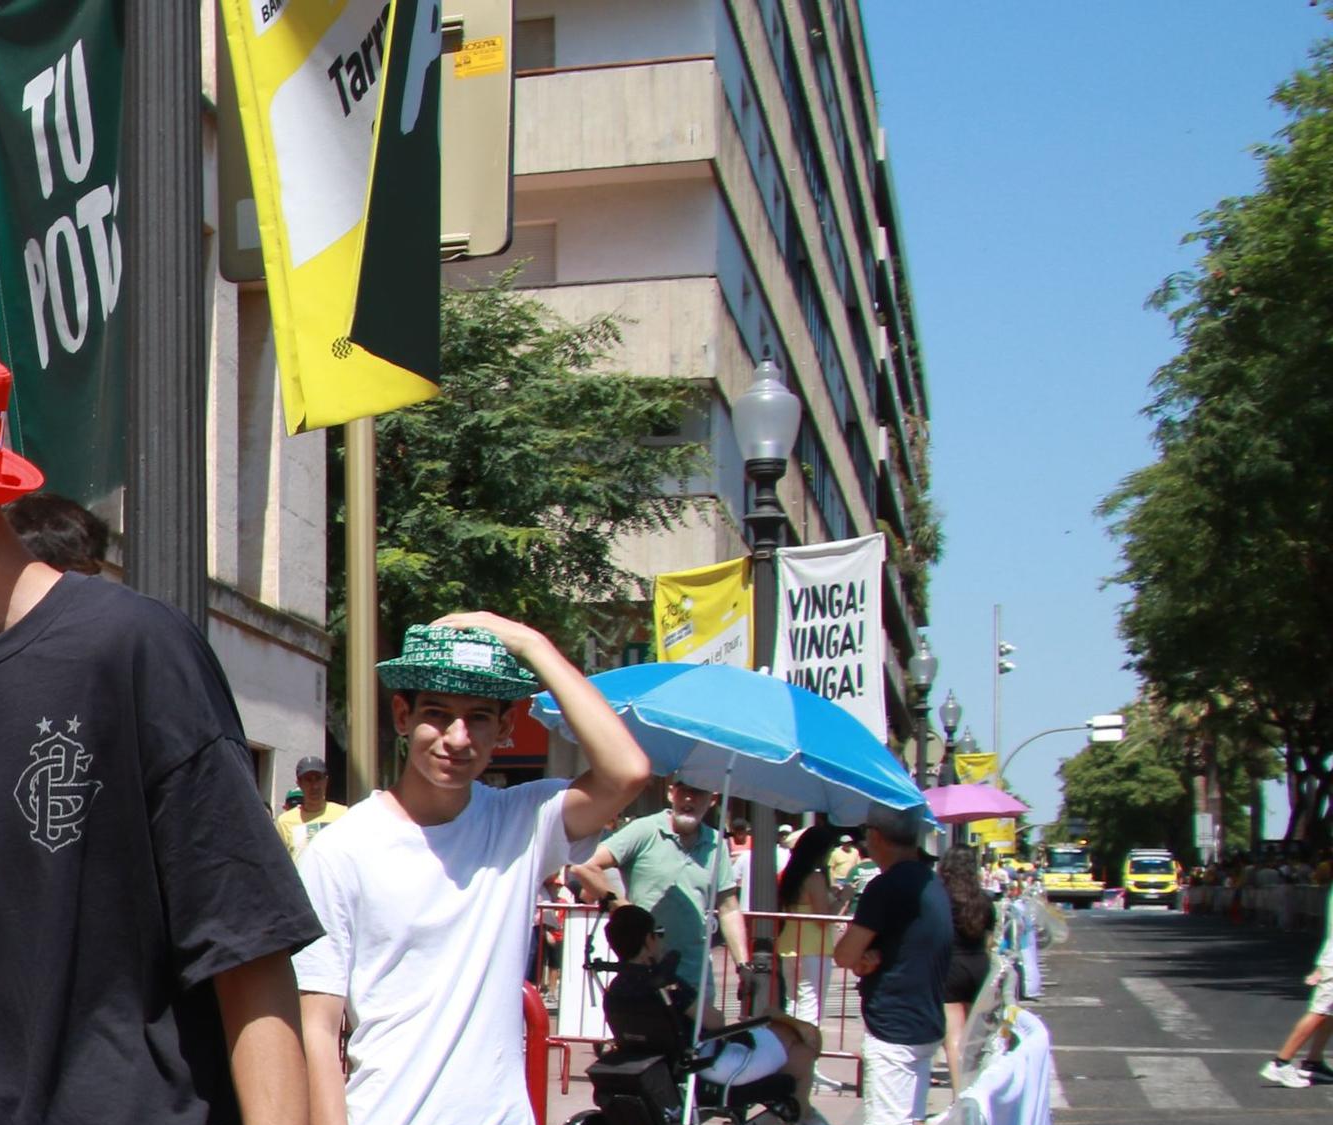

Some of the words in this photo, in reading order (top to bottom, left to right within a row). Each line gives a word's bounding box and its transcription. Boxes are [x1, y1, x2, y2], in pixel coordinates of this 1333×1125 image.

[22, 38, 95, 200] TU
[788, 580, 865, 622] VINGA!
[789, 621, 863, 662] VINGA!
